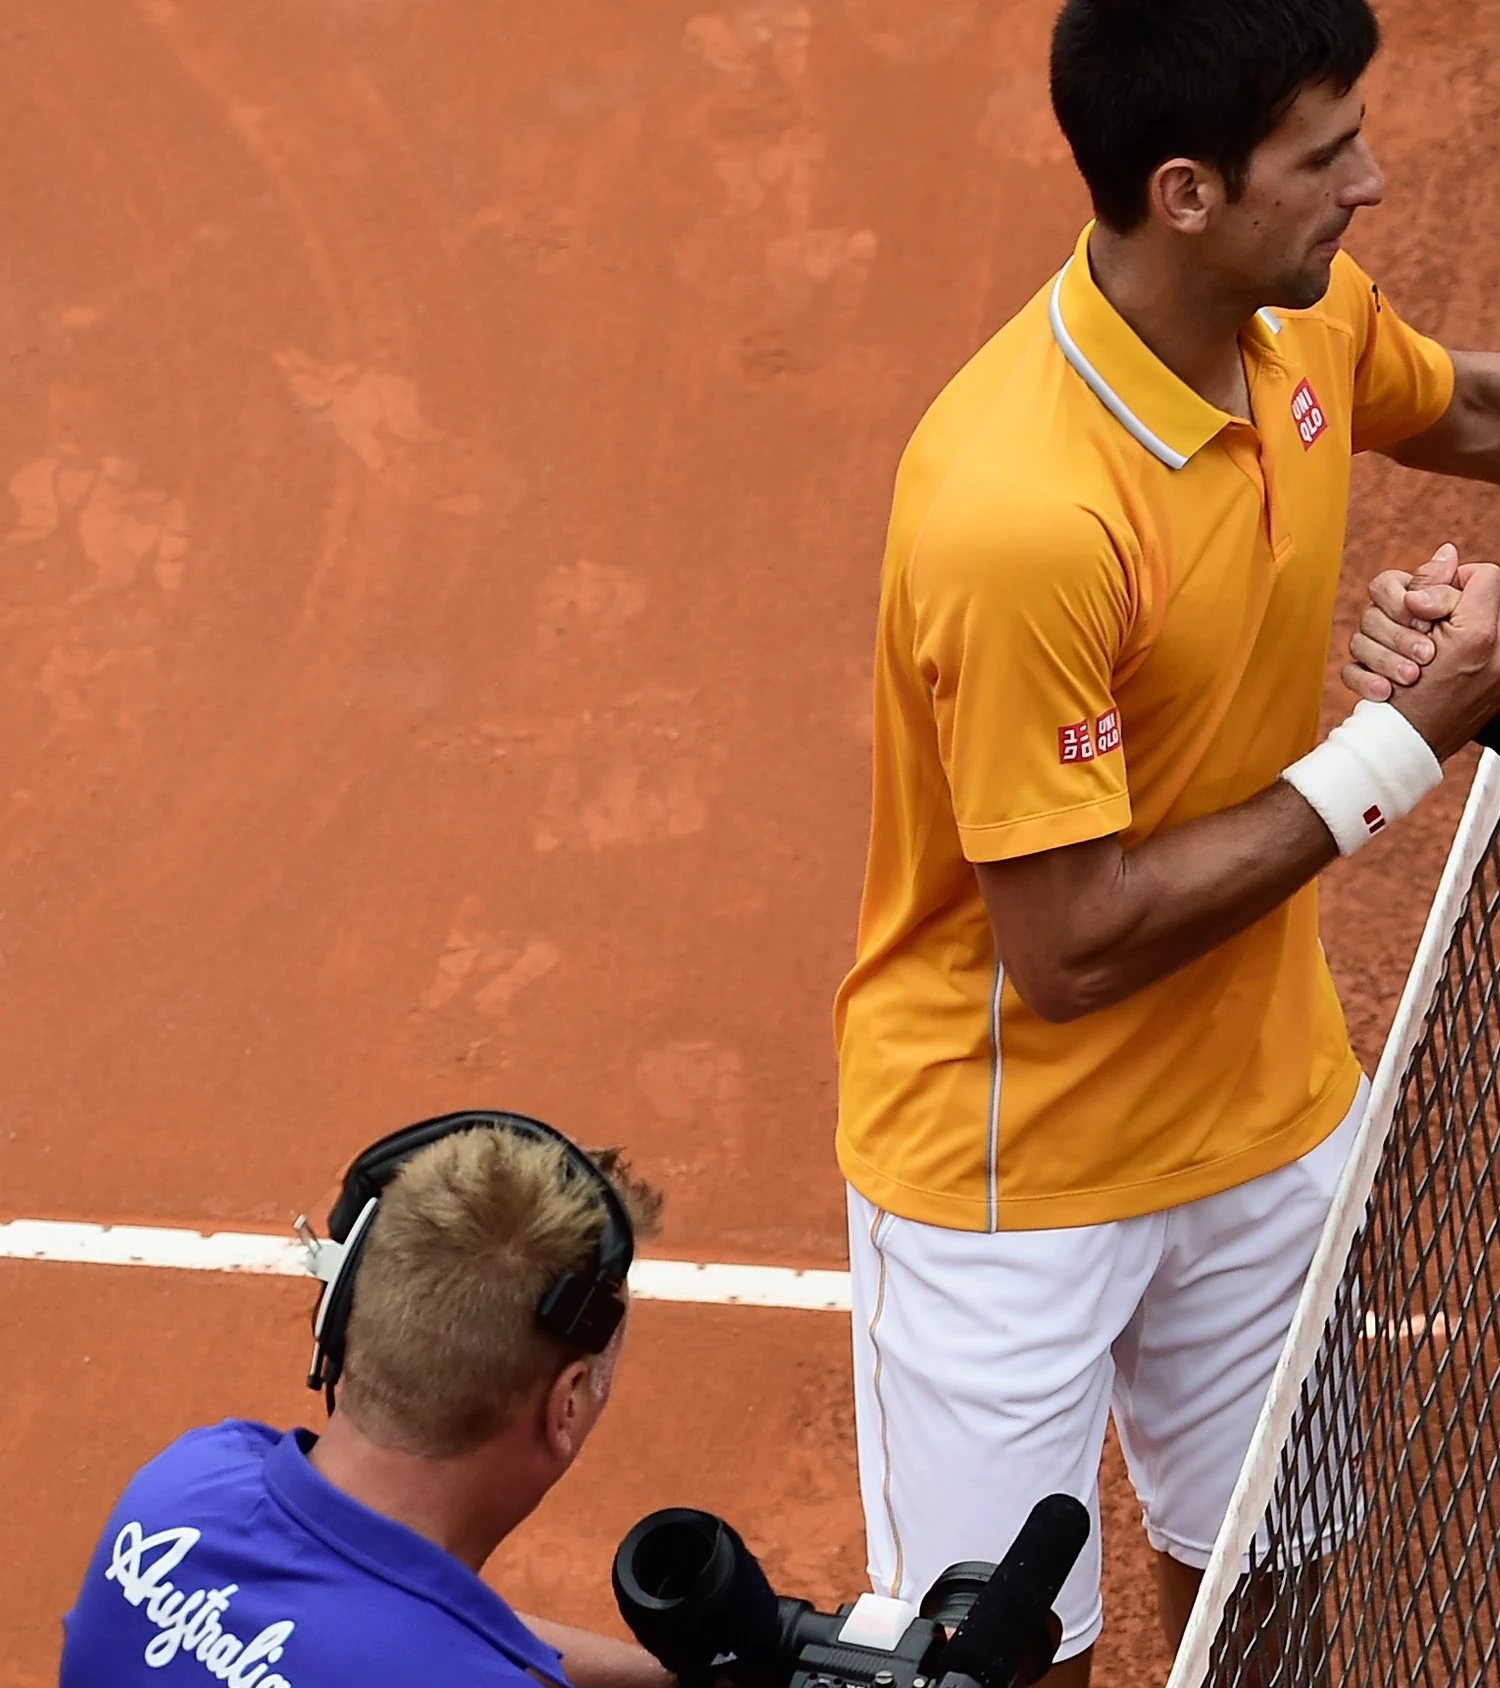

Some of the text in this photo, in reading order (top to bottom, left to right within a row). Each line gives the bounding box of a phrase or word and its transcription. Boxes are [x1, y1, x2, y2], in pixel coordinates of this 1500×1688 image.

[1292, 387, 1313, 420] UNI
[1300, 407, 1323, 442] QLO
[1098, 713, 1115, 734] UNI
[1098, 728, 1119, 751] QLO
